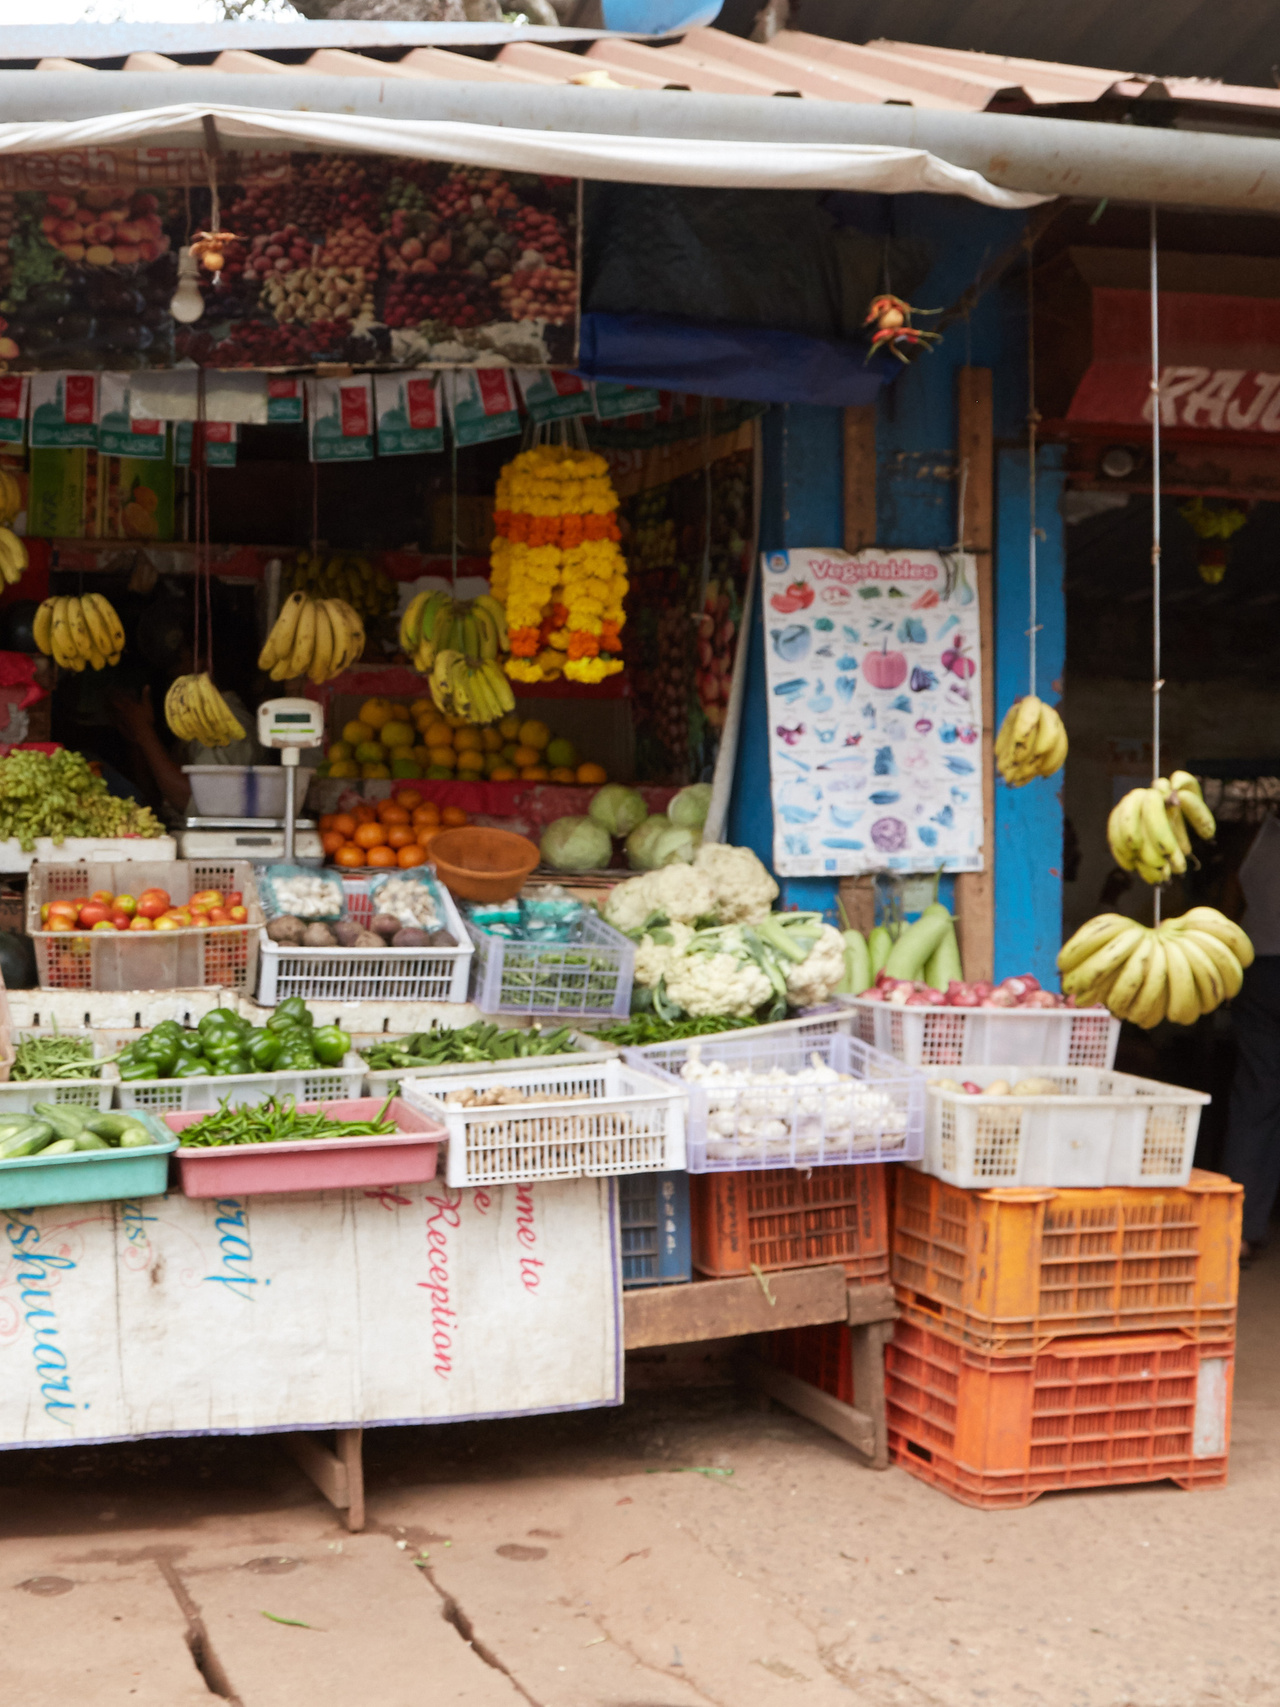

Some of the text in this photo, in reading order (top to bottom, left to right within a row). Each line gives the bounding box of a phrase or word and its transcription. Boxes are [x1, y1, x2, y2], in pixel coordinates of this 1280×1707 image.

[135, 147, 290, 182] Fruts
[808, 558, 938, 585] Vegetables
[416, 1185, 463, 1381] Reception
[520, 1257, 544, 1295] to
[3, 1207, 91, 1426] shwari
